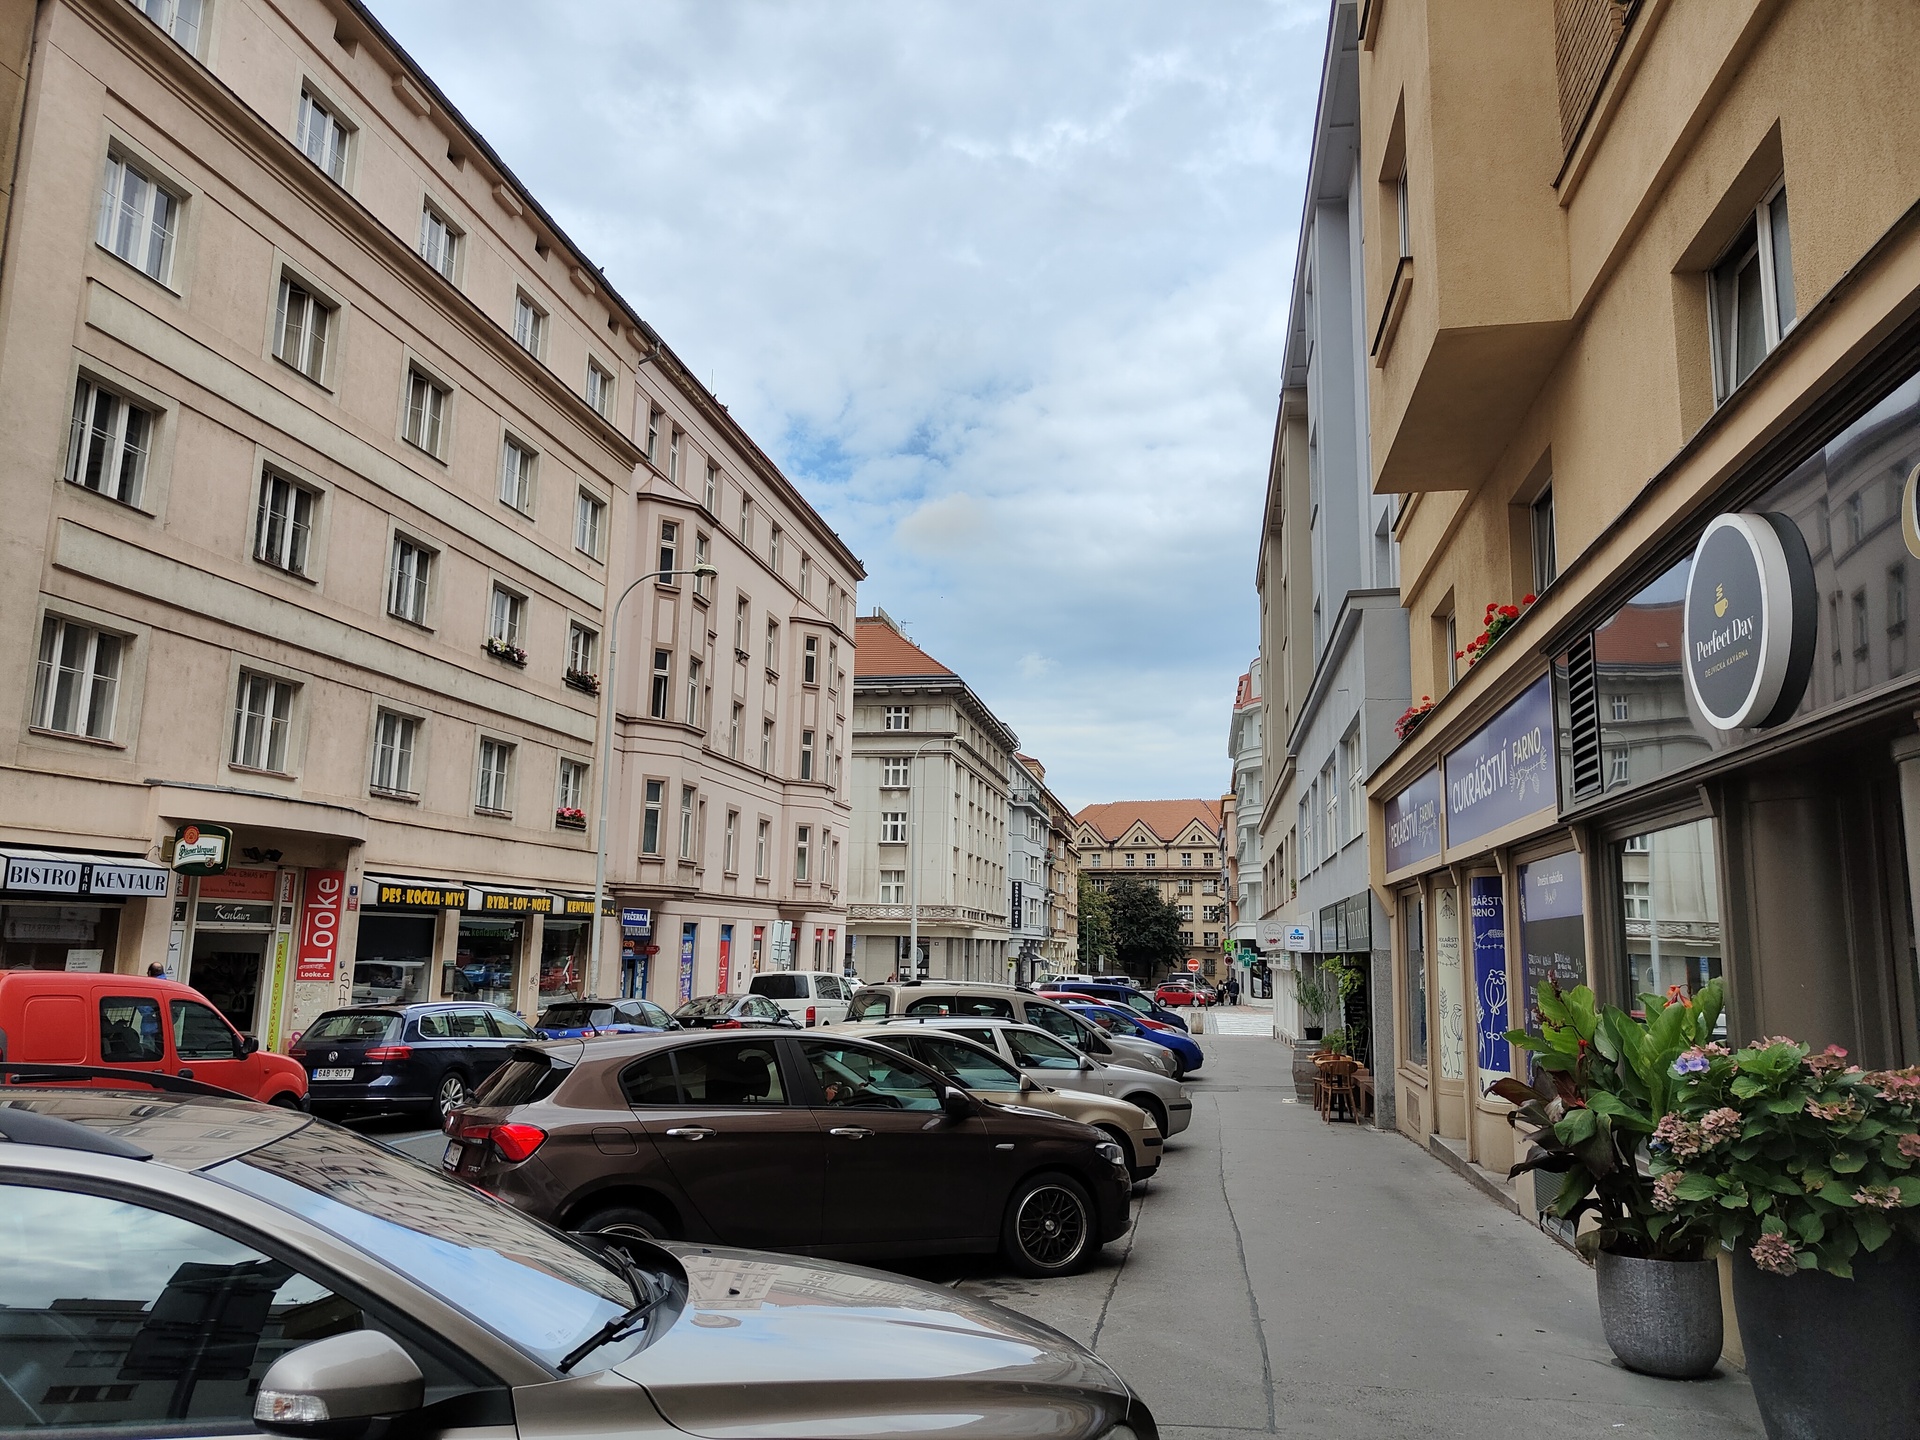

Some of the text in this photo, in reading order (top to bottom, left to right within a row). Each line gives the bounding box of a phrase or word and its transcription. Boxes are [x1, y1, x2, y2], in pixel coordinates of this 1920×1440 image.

[1696, 615, 1754, 662] Perfect Day
[1452, 727, 1542, 814] CUKRÁŘSTVÍ FARNO
[1390, 799, 1435, 849] PEKAŘSTVÍ FARNO
[10, 865, 77, 887] BISTRO
[82, 866, 91, 891] BAR
[94, 871, 166, 891] KENTAUR
[381, 887, 466, 907] PES KOČKA MYŠ
[486, 895, 551, 912] RYBA LOV NOŽE
[214, 904, 251, 921] Kentaur
[623, 911, 648, 922] VEČERKA
[318, 1069, 352, 1078] 6AB 9017
